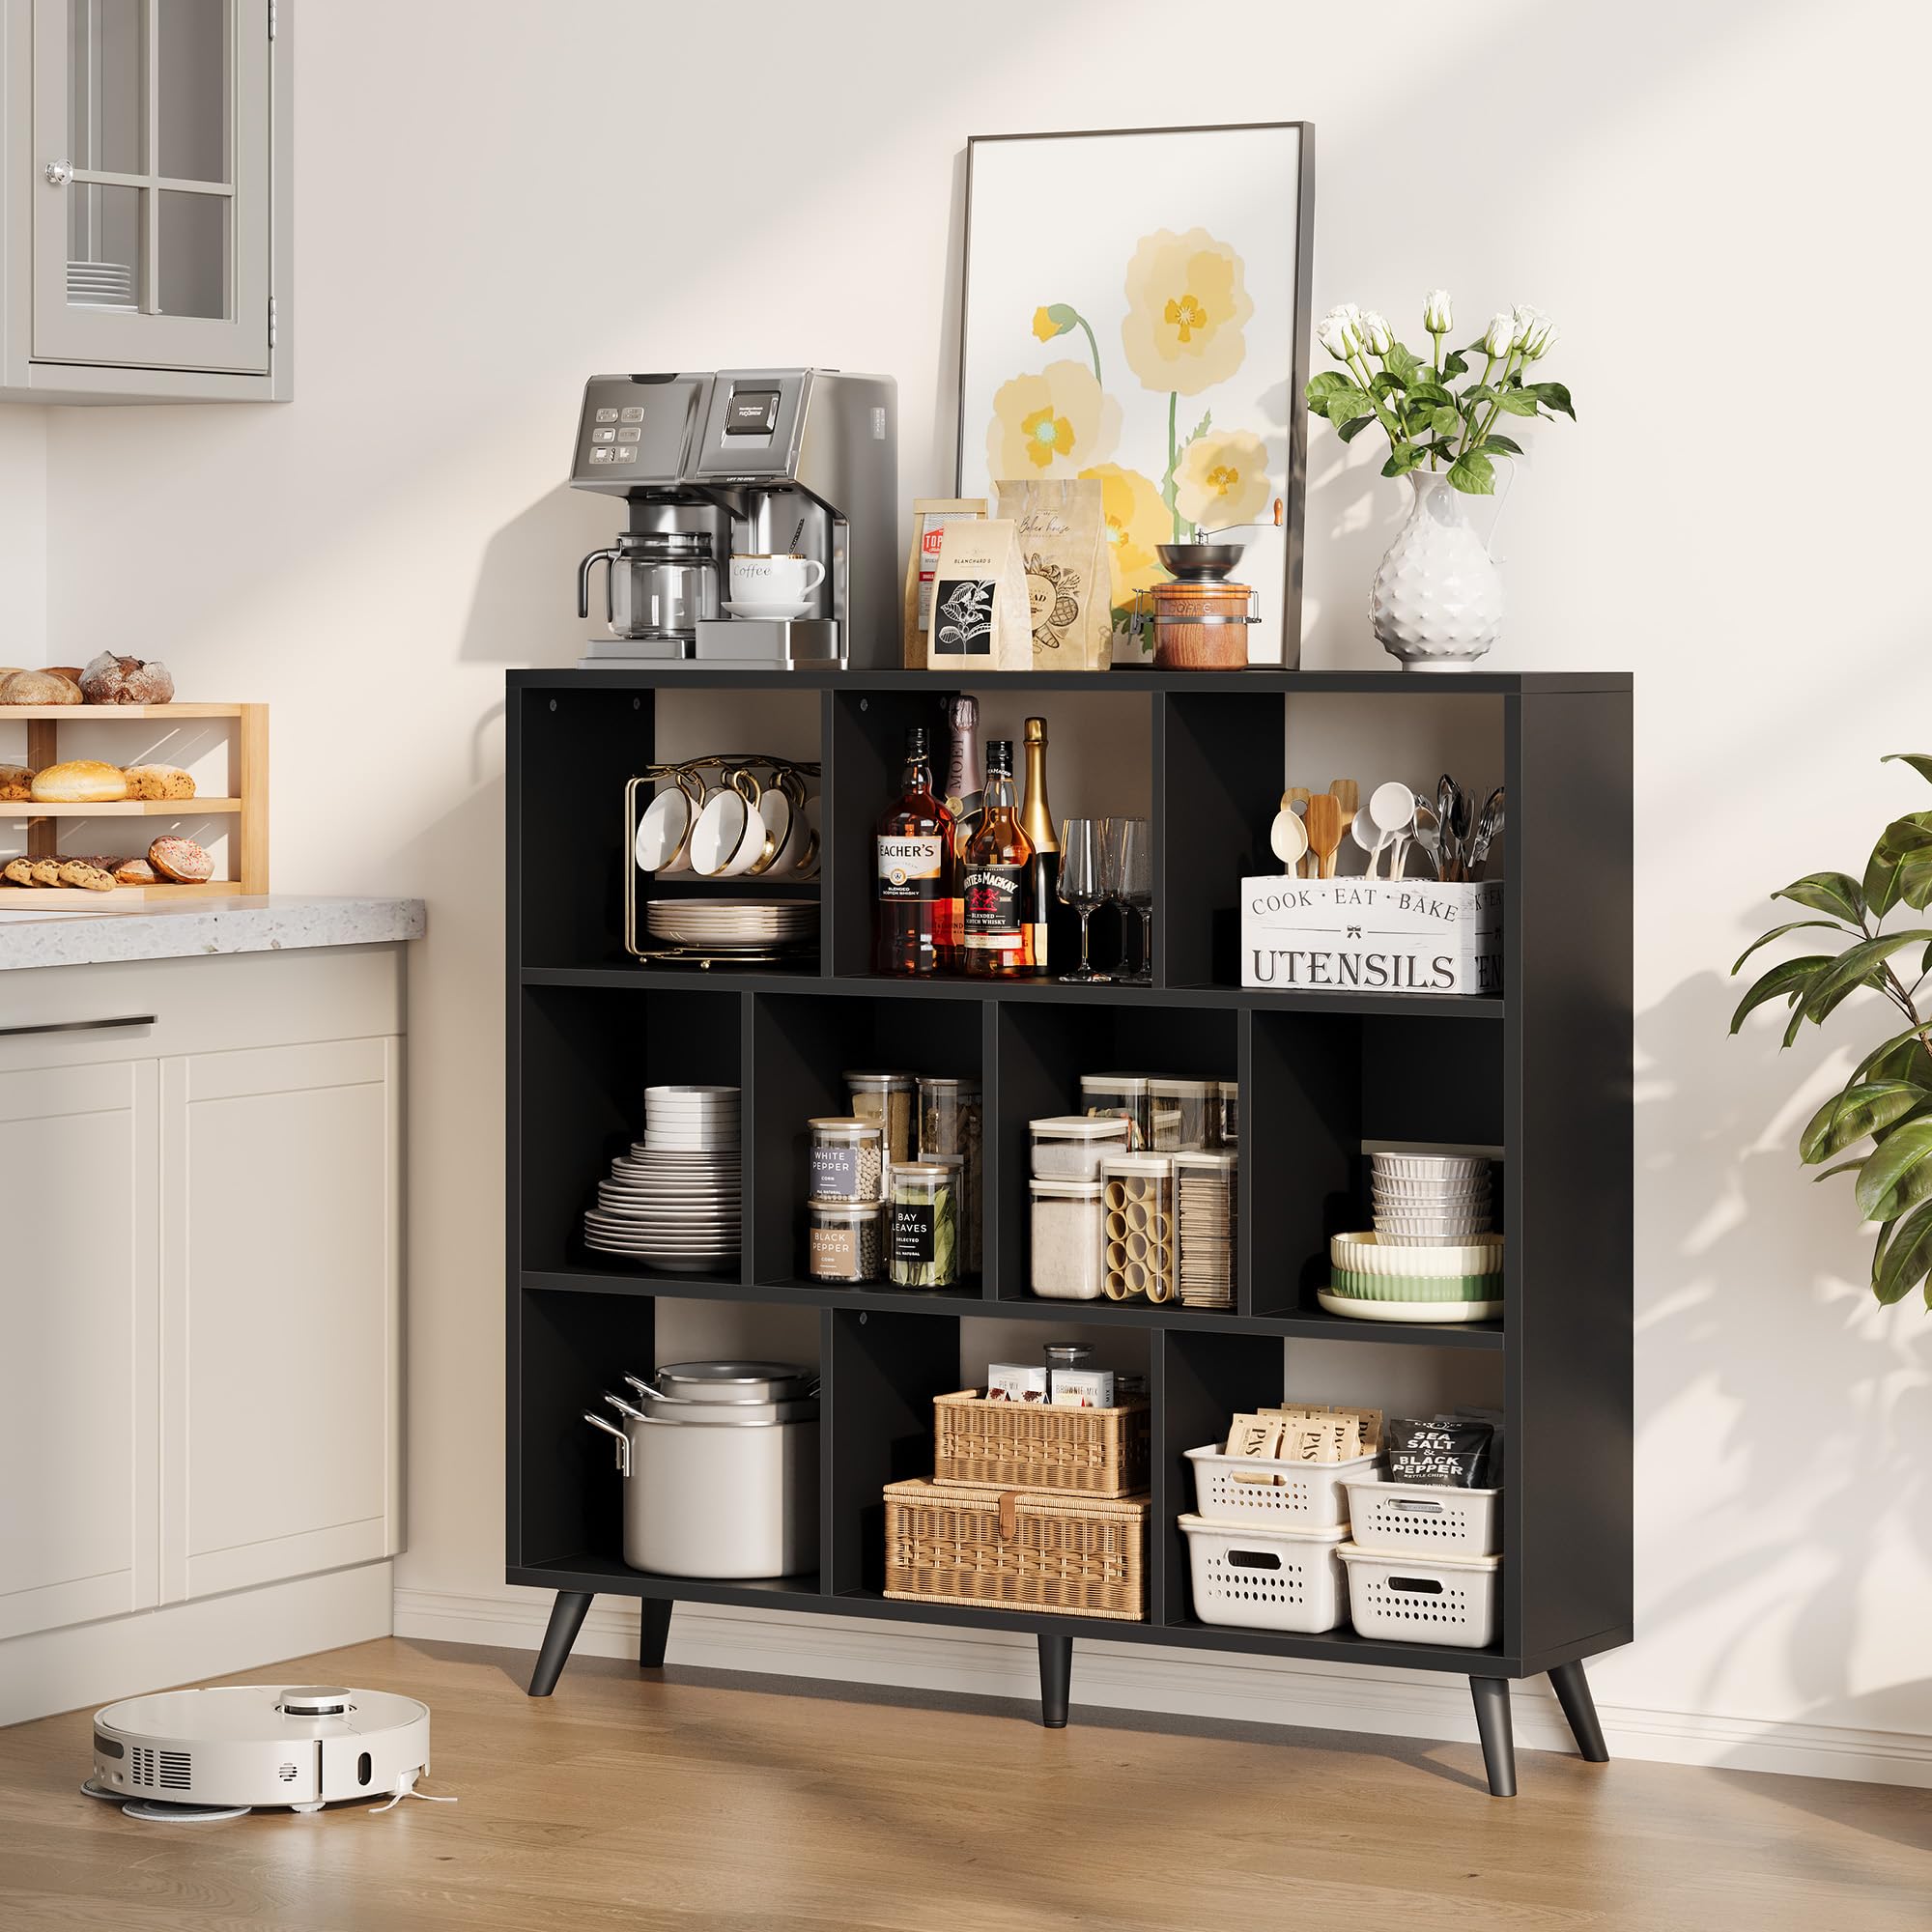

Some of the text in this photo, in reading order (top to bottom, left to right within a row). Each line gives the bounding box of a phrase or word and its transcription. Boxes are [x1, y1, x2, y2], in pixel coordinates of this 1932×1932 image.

[733, 563, 771, 578] Coffee
[880, 843, 934, 857] EACHER'S
[982, 871, 1018, 895] MACKAY
[1252, 890, 1313, 916] COOK
[1335, 888, 1377, 905] EAT
[1399, 894, 1460, 923] BAKE
[1252, 950, 1455, 989] UTENSILS
[814, 1151, 845, 1161] WHITE
[812, 1161, 849, 1172] PEPPER
[897, 1212, 917, 1222] BAY
[892, 1223, 927, 1233] LEAVES
[814, 1232, 845, 1242] BLACK
[812, 1243, 849, 1253] PEPPER
[1055, 1383, 1098, 1396] BROWNIE MIX
[1413, 1432, 1451, 1440] SEA
[1245, 1428, 1266, 1457] PAS
[1301, 1433, 1321, 1462] PAS
[1406, 1439, 1456, 1450] SALT
[1399, 1456, 1461, 1465] BLACK
[1392, 1463, 1463, 1475] PEPPER
